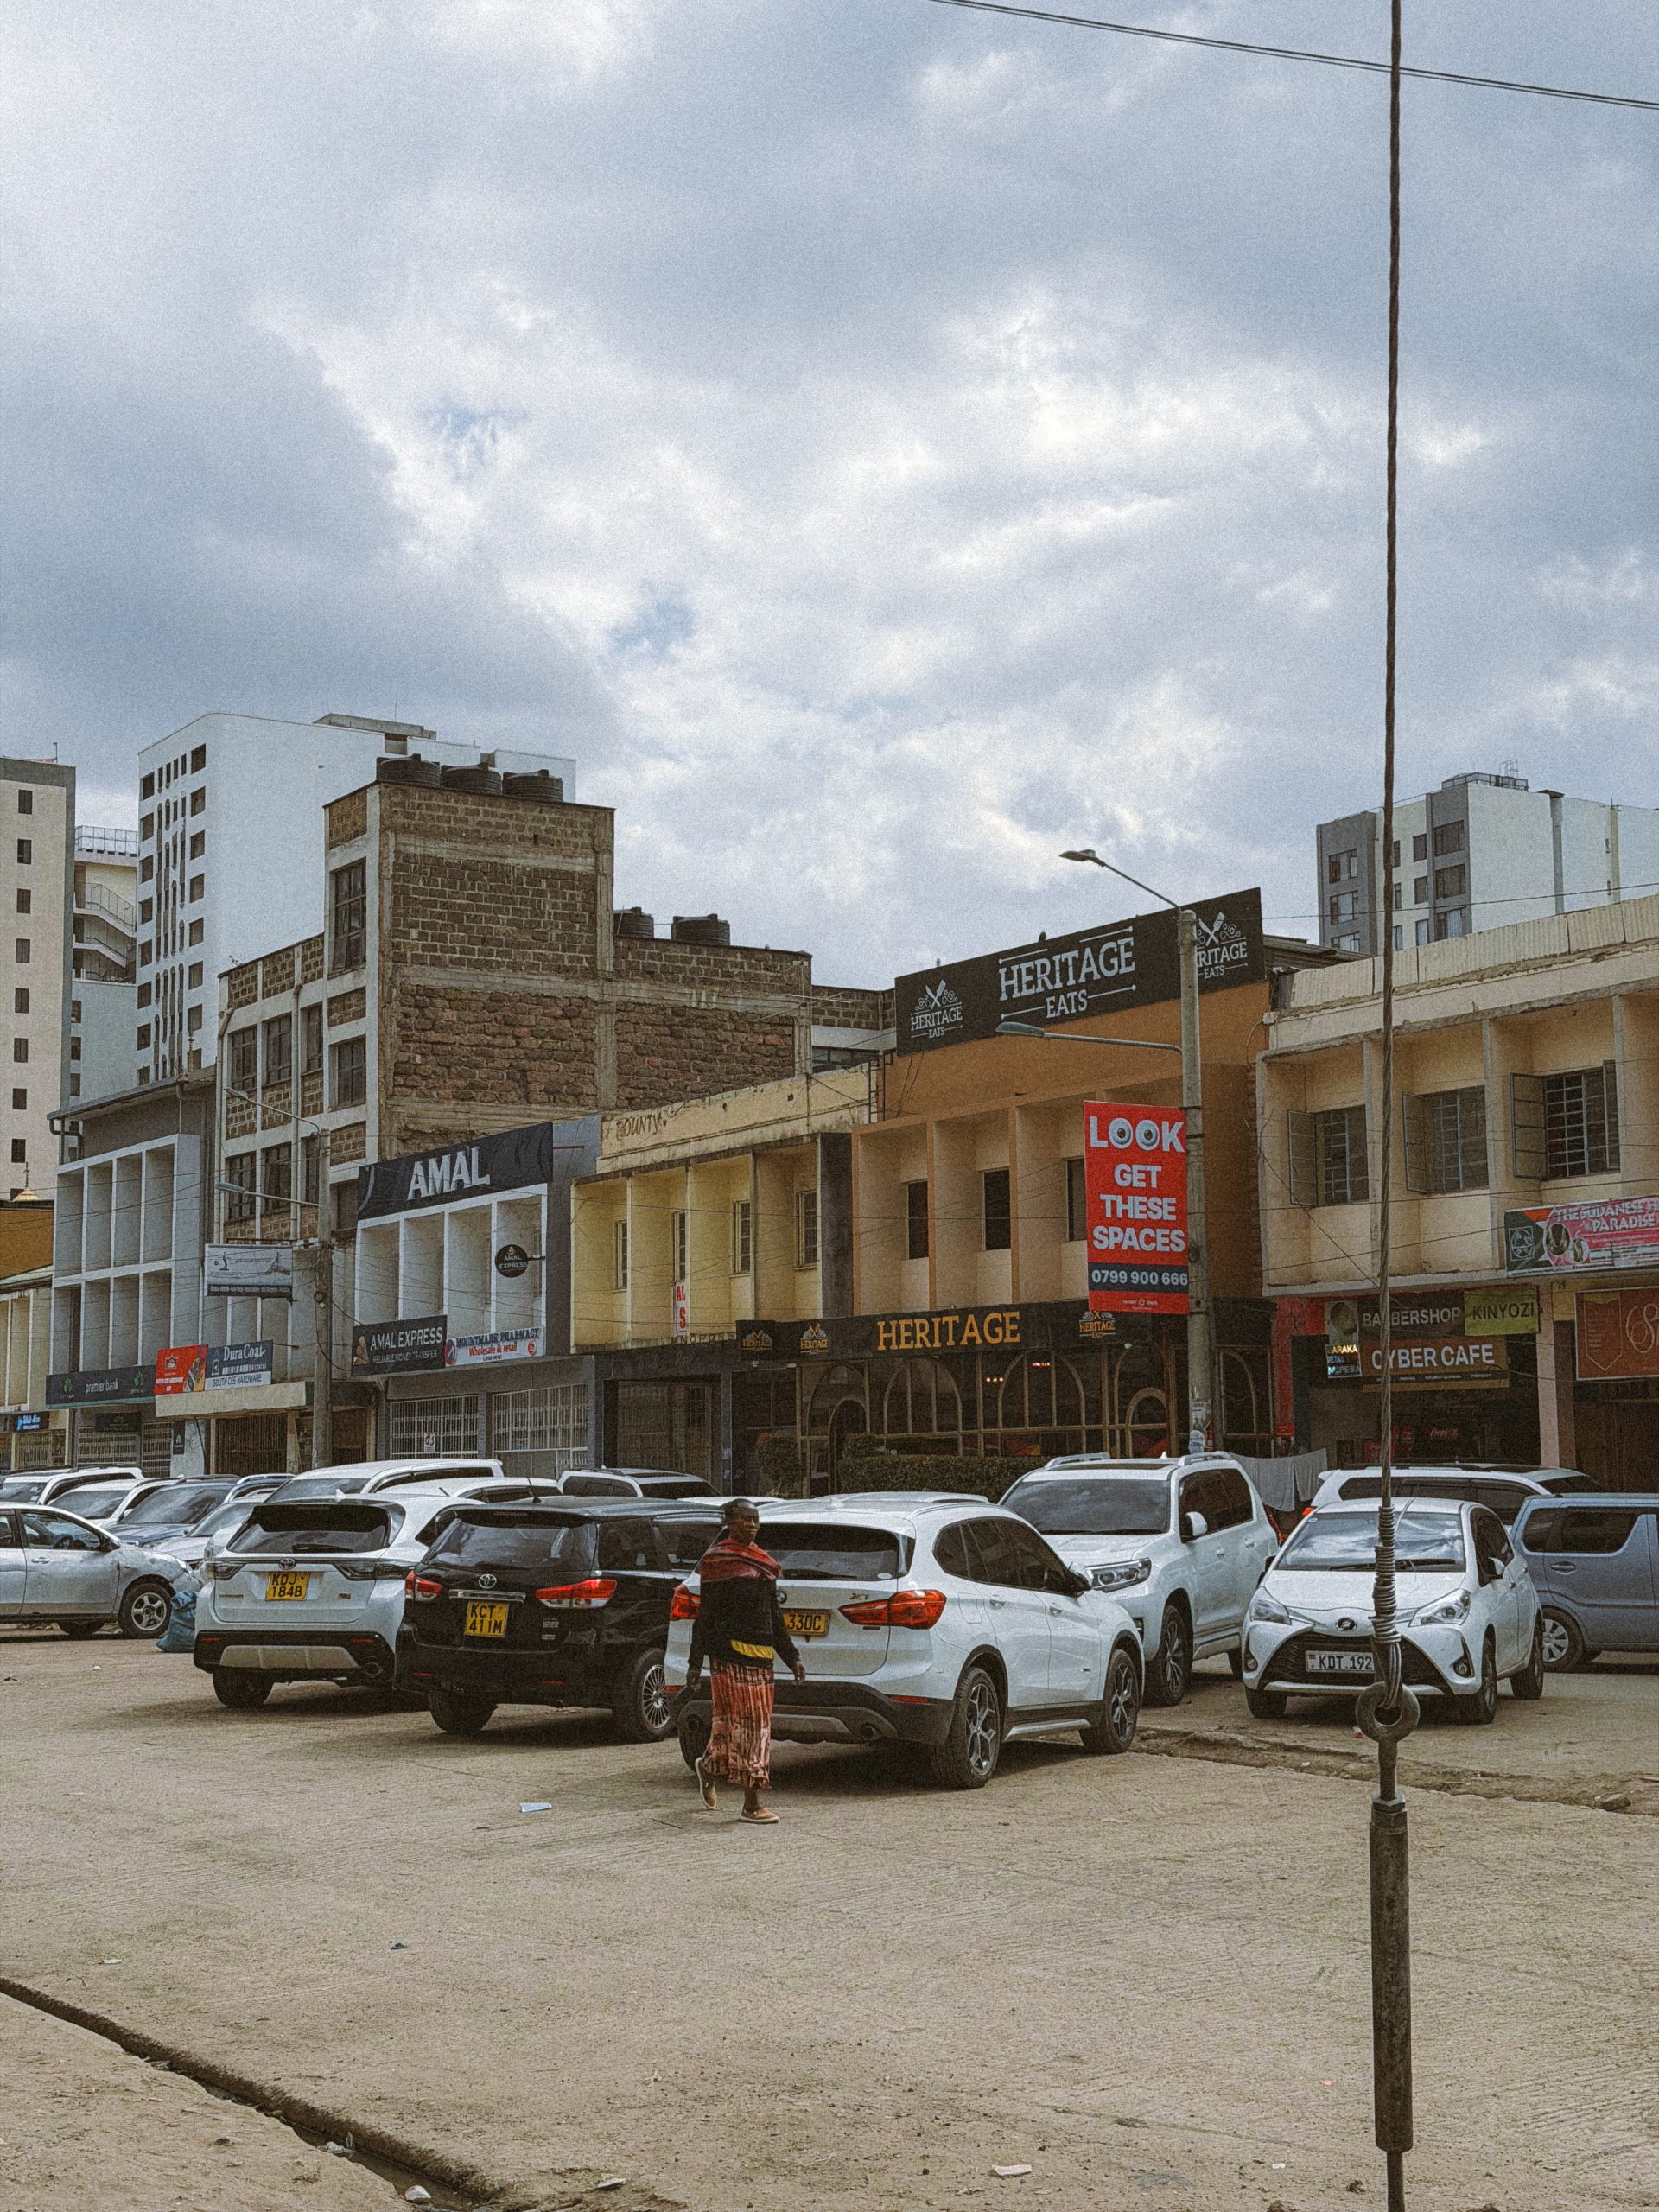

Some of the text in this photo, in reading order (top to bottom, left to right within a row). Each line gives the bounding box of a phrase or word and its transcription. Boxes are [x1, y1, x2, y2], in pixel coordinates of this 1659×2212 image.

[1197, 942, 1248, 967] RITAGE
[999, 937, 1135, 1001] HERITAGE
[1204, 965, 1224, 979] EATS
[1046, 989, 1088, 1019] EATS
[911, 1006, 963, 1031] HERITAGE
[928, 1027, 945, 1038] EATS
[1090, 1116, 1185, 1153] LOOK
[407, 1147, 491, 1201] AMAL
[1114, 1163, 1161, 1189] GET
[1100, 1194, 1176, 1221] THESE
[1556, 1210, 1580, 1221] THE
[1580, 1202, 1643, 1219] SUDANESE
[1592, 1213, 1655, 1231] PARADISE
[1093, 1225, 1185, 1253] SPACES
[1091, 1269, 1188, 1286] 0799 900 666
[1363, 1307, 1460, 1327] BABERSHOP
[1472, 1302, 1535, 1320] KINYOZI
[877, 1311, 1020, 1351] HERITAGE
[1079, 1321, 1116, 1332] HERITAGE
[370, 1327, 442, 1351] AMAL EXPRESS
[469, 1344, 495, 1356] Wholesale
[1328, 1344, 1358, 1354] ARAKA
[1371, 1344, 1495, 1370] CYBER CAFE
[86, 1378, 119, 1395] premier bank
[237, 1374, 262, 1384] HARDWARE
[272, 1574, 296, 1586] KDJ
[272, 1586, 302, 1598] 184B
[470, 1604, 496, 1618] KCT
[469, 1619, 502, 1633] 411M
[787, 1614, 822, 1631] 330C
[1319, 1655, 1344, 1669] KDT
